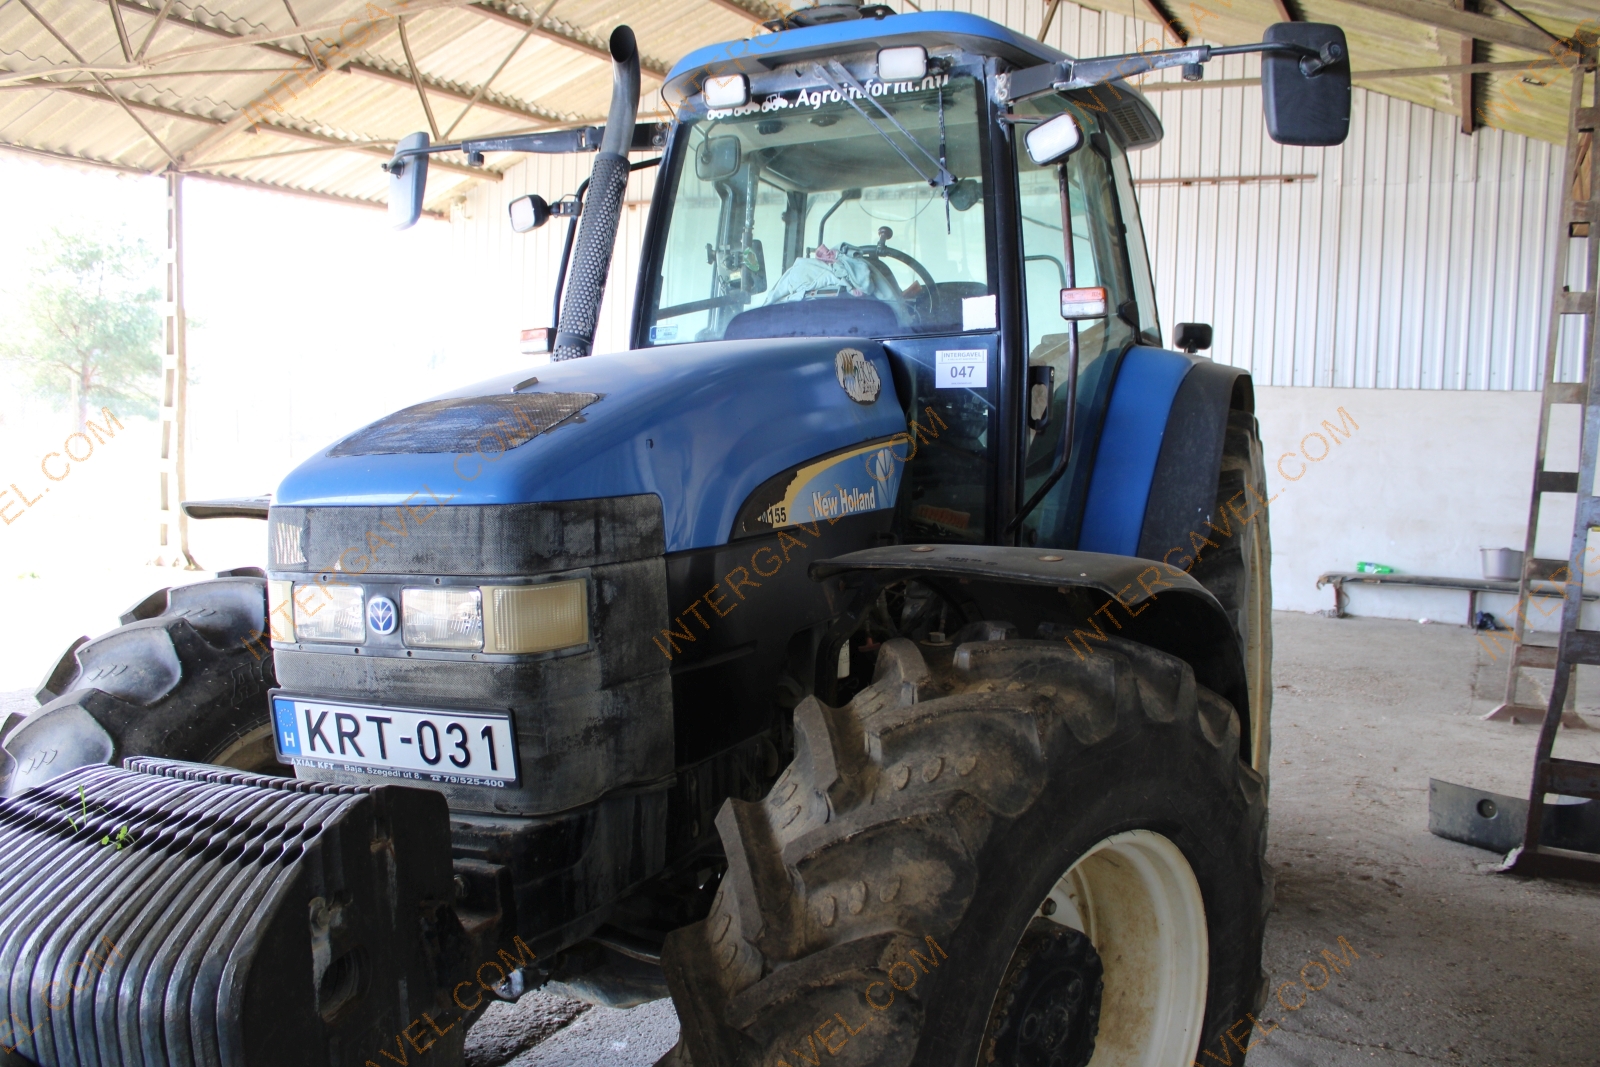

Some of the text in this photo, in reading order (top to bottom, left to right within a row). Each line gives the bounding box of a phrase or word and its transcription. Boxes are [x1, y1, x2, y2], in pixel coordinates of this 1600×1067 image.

[950, 365, 975, 378] 047
[812, 486, 875, 518] New Holland
[284, 732, 296, 748] H
[304, 708, 498, 771] KRT-031
[290, 757, 316, 768] AXIAL
[317, 761, 335, 770] KFT
[344, 764, 366, 774] Baja,
[367, 767, 400, 777] Szegedi
[443, 775, 505, 788] 79/525-400
